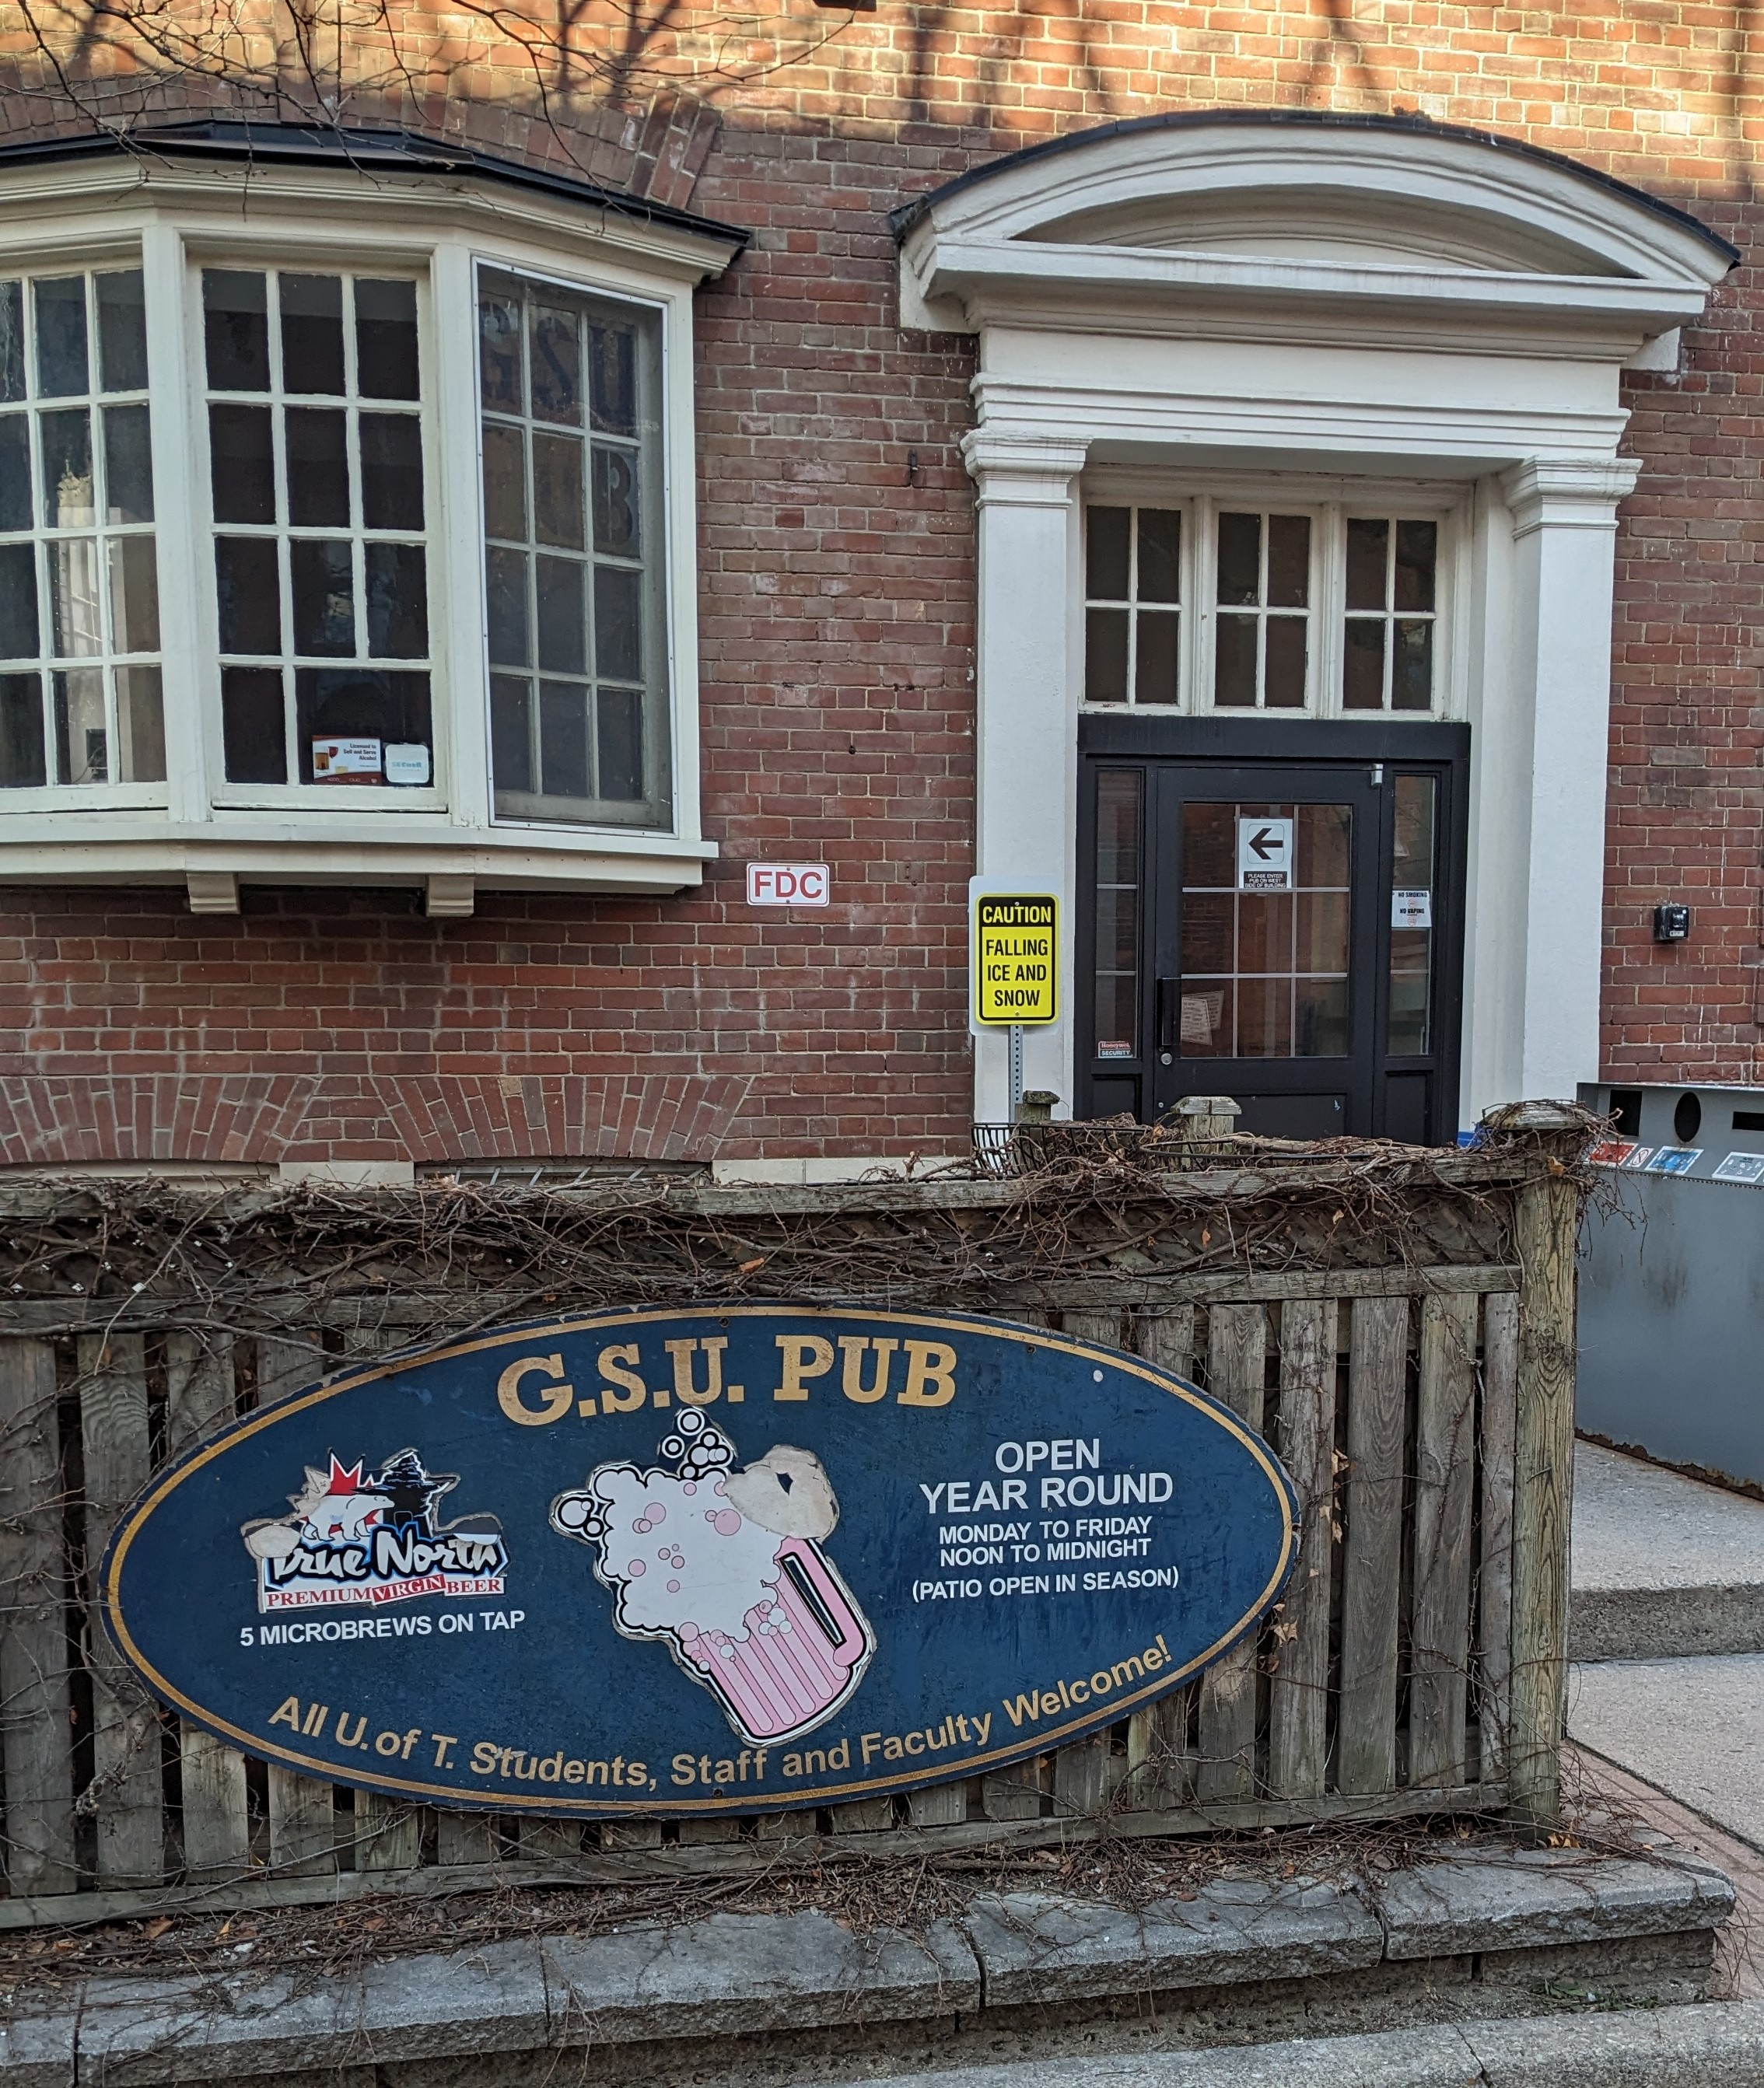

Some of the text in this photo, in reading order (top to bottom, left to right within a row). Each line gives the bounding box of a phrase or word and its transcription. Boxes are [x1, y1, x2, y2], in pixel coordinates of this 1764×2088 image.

[754, 871, 823, 898] FDC
[982, 904, 1052, 924] CAUTION
[985, 938, 1048, 957] FALLING
[987, 964, 1047, 981] ICE AND
[993, 989, 1041, 1007] SNOW
[497, 1334, 957, 1426] G.S.U. PUB
[995, 1438, 1100, 1474] OPEN
[919, 1472, 1174, 1514] YEAR ROUND
[940, 1516, 1153, 1544] MONDAY TO FRIDAY
[940, 1537, 1152, 1567] NOON TO MIDNIGHT
[267, 1576, 502, 1607] PREMIUM VIRGIN BEER
[912, 1565, 1179, 1603] (PATIO OPEN IN SEASON)
[240, 1610, 526, 1647] 5 MICROBREWS ON TAP
[268, 1695, 329, 1738] All
[429, 1733, 458, 1770] T.
[469, 1740, 658, 1792] Students,
[670, 1748, 767, 1786] Staff
[782, 1739, 851, 1778] and
[860, 1712, 992, 1764] Faculty
[1002, 1634, 1173, 1728] Welcome!
